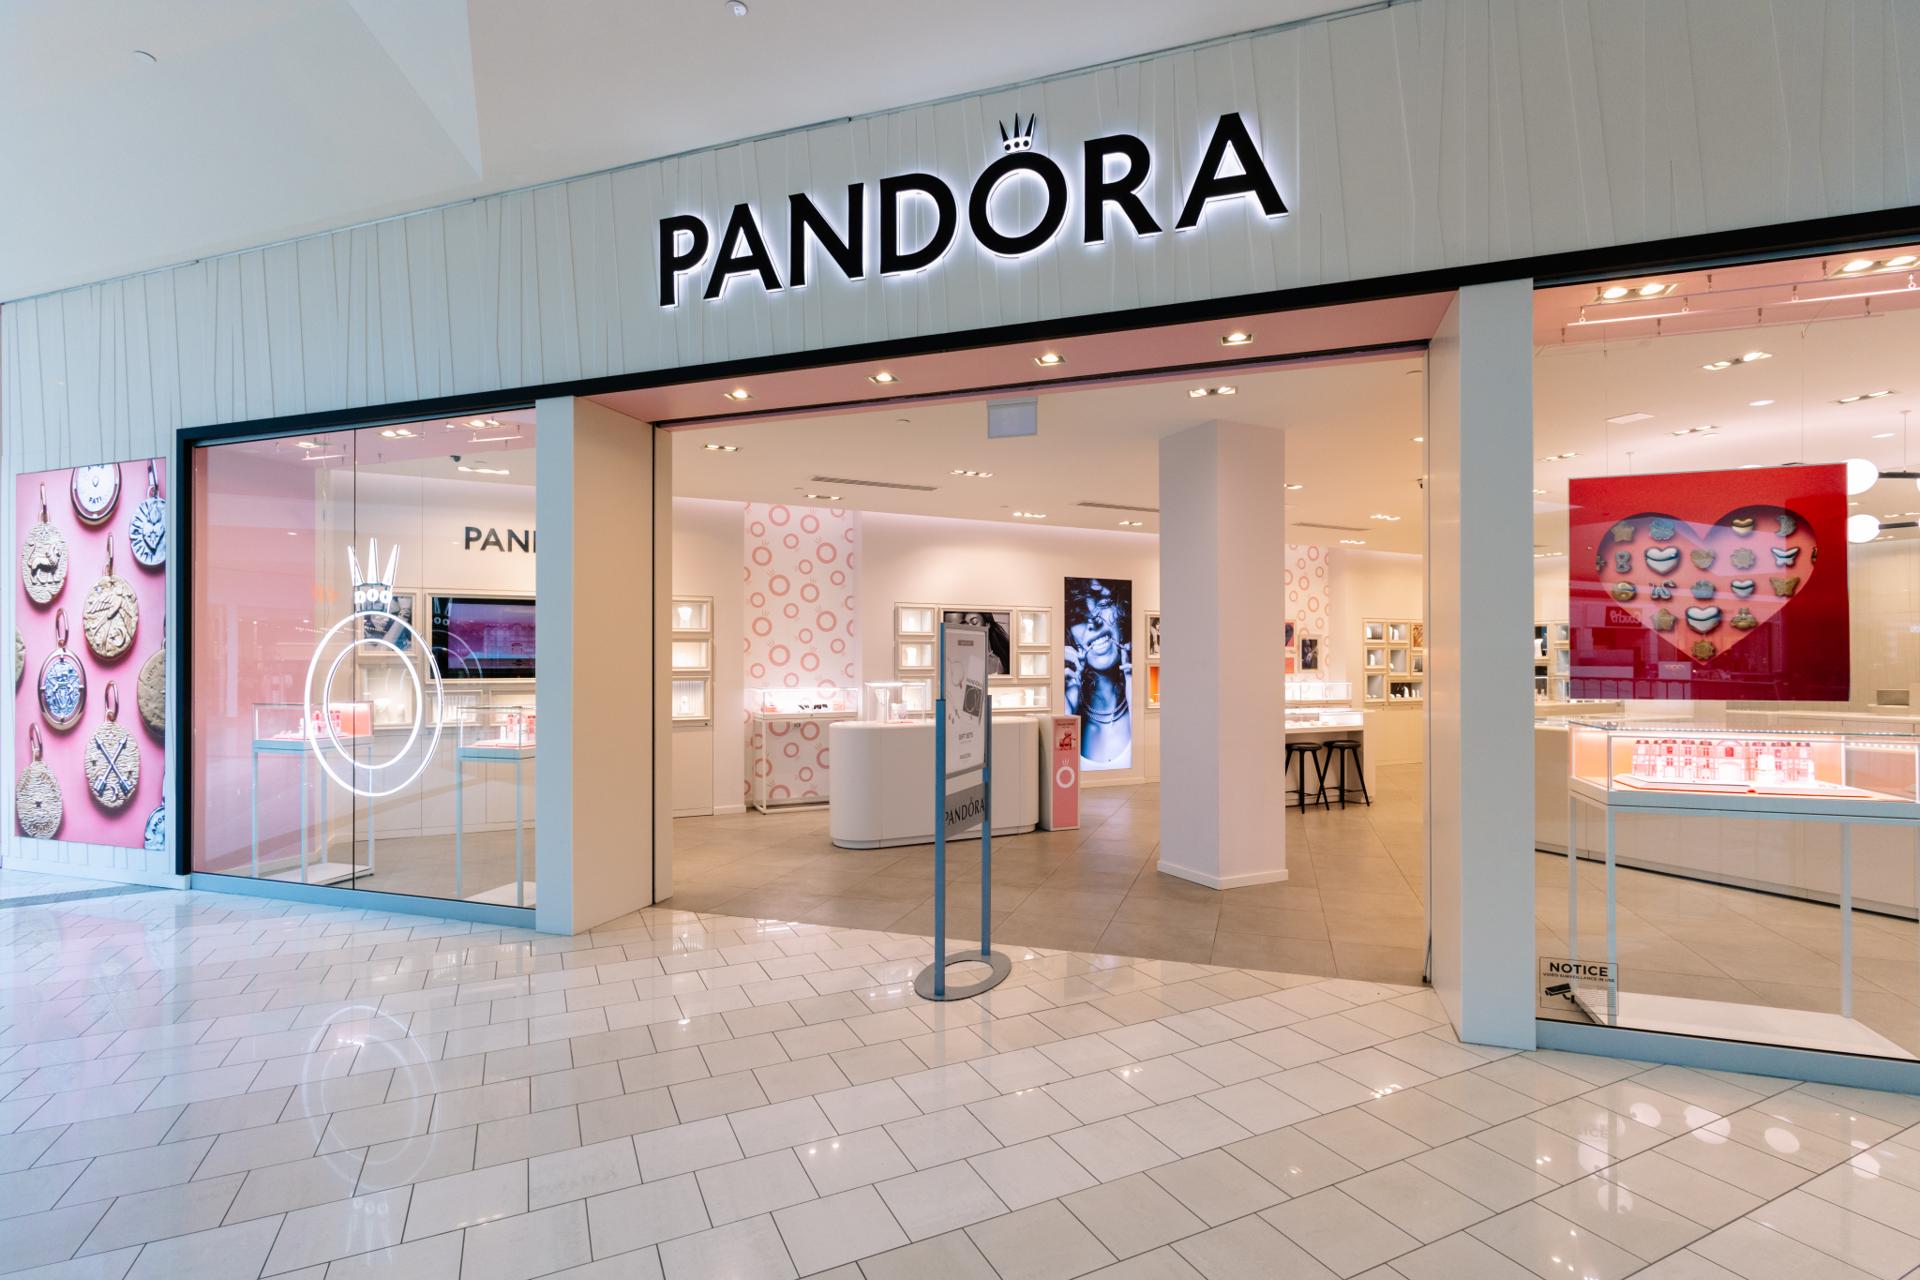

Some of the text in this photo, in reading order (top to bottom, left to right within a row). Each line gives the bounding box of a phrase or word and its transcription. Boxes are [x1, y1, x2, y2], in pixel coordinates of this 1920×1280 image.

[659, 112, 1288, 307] PANDORA
[465, 526, 536, 553] PAN
[1550, 962, 1608, 976] NOTICE
[1560, 973, 1597, 981] SURVEILLANCE
